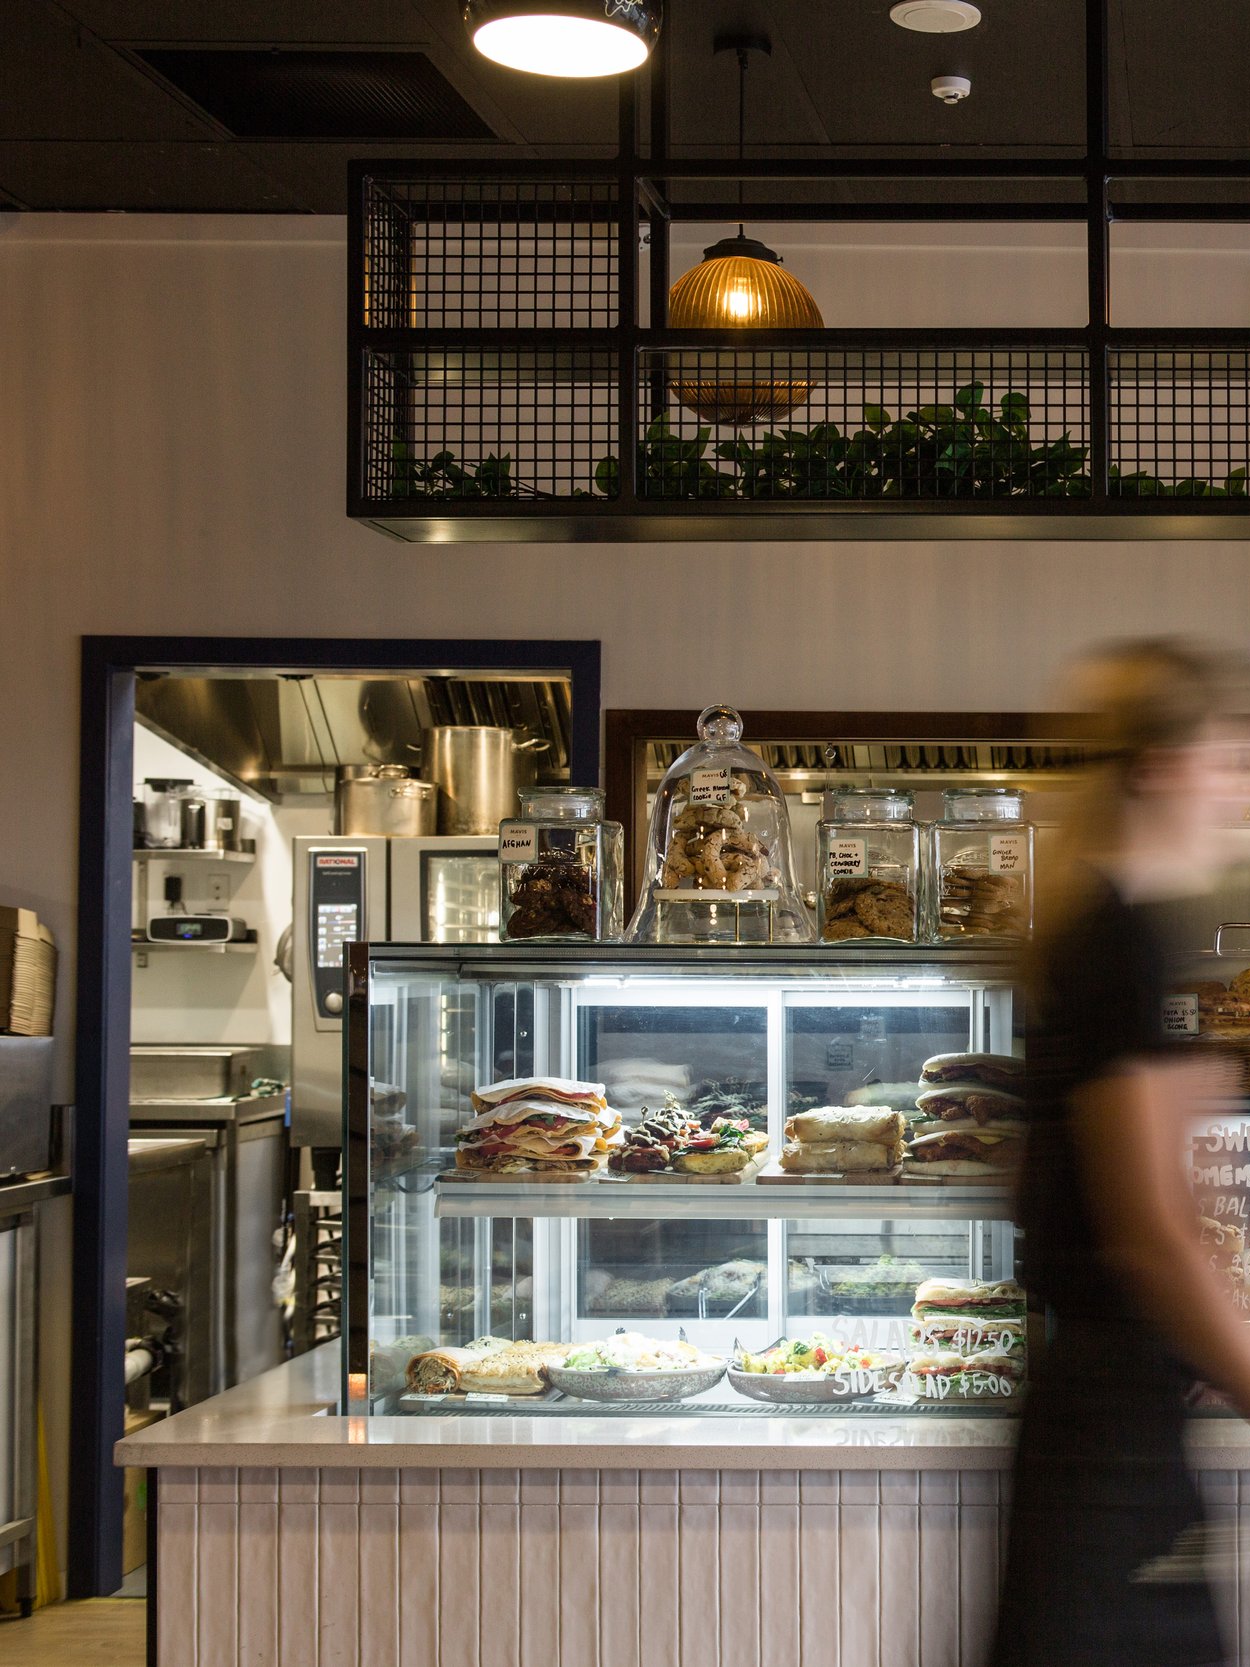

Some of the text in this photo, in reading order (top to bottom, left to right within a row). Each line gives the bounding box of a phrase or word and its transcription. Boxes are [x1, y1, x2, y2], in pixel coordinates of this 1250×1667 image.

[502, 839, 532, 849] AFGHAN
[952, 1326, 1014, 1358] $12.50
[832, 1367, 1012, 1400] SIDE SALAD $5.00
